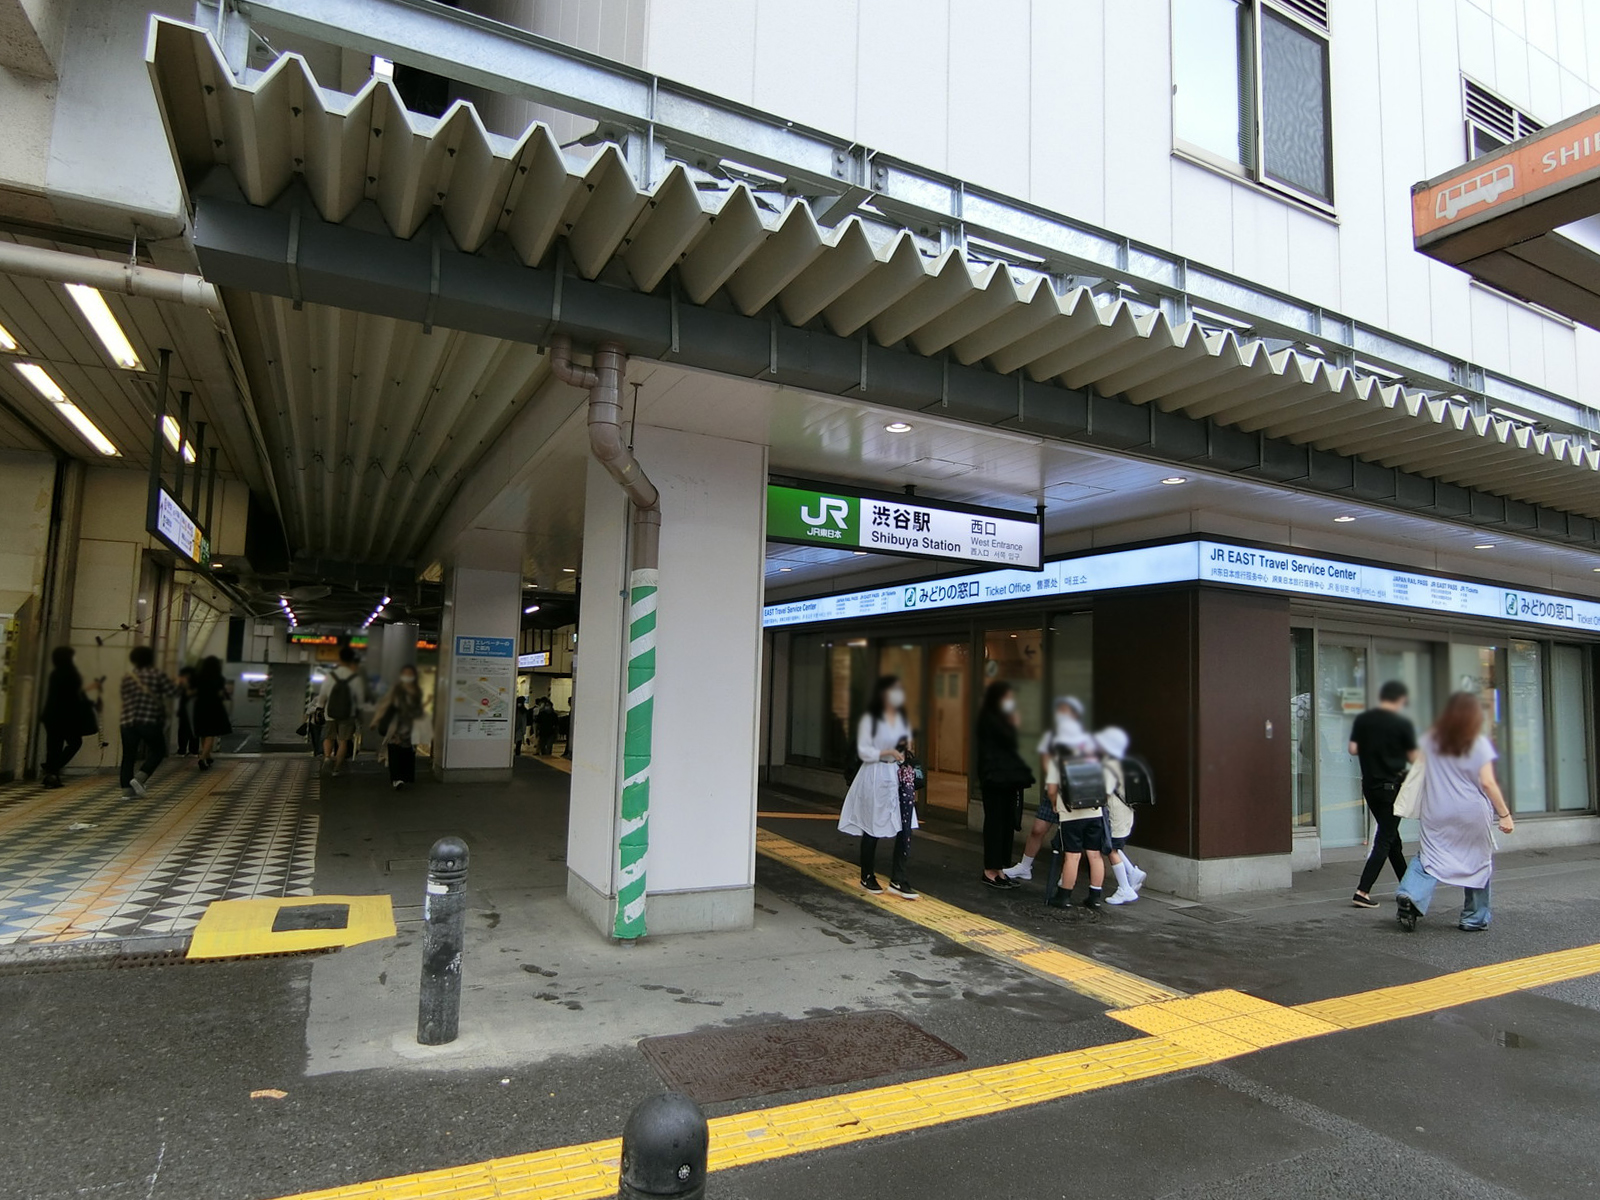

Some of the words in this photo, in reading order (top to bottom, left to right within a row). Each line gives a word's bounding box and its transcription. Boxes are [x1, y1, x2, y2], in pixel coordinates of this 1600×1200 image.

[801, 497, 848, 529] JR
[872, 505, 931, 532] 渋谷駅
[806, 527, 842, 539] JR東日本
[971, 519, 996, 536] 西口
[872, 531, 918, 549] Shibuya
[922, 537, 961, 552] Station
[971, 537, 989, 547] West
[992, 539, 1023, 551] Entrance
[1210, 548, 1225, 561] JR
[1228, 550, 1256, 566] EAST
[1259, 555, 1289, 570] Travel
[1291, 560, 1326, 576] Service
[1328, 565, 1357, 580] Center
[1064, 575, 1087, 586] 매표소
[1417, 579, 1428, 587] PASS
[1447, 583, 1458, 591] PASS
[919, 581, 980, 603] みどりの窓口
[985, 586, 1007, 597] Ticket
[1008, 582, 1031, 594] Office
[775, 606, 787, 615] Travel
[787, 604, 802, 614] Service
[803, 602, 817, 611] Center
[1521, 598, 1574, 621] みどりの窓口
